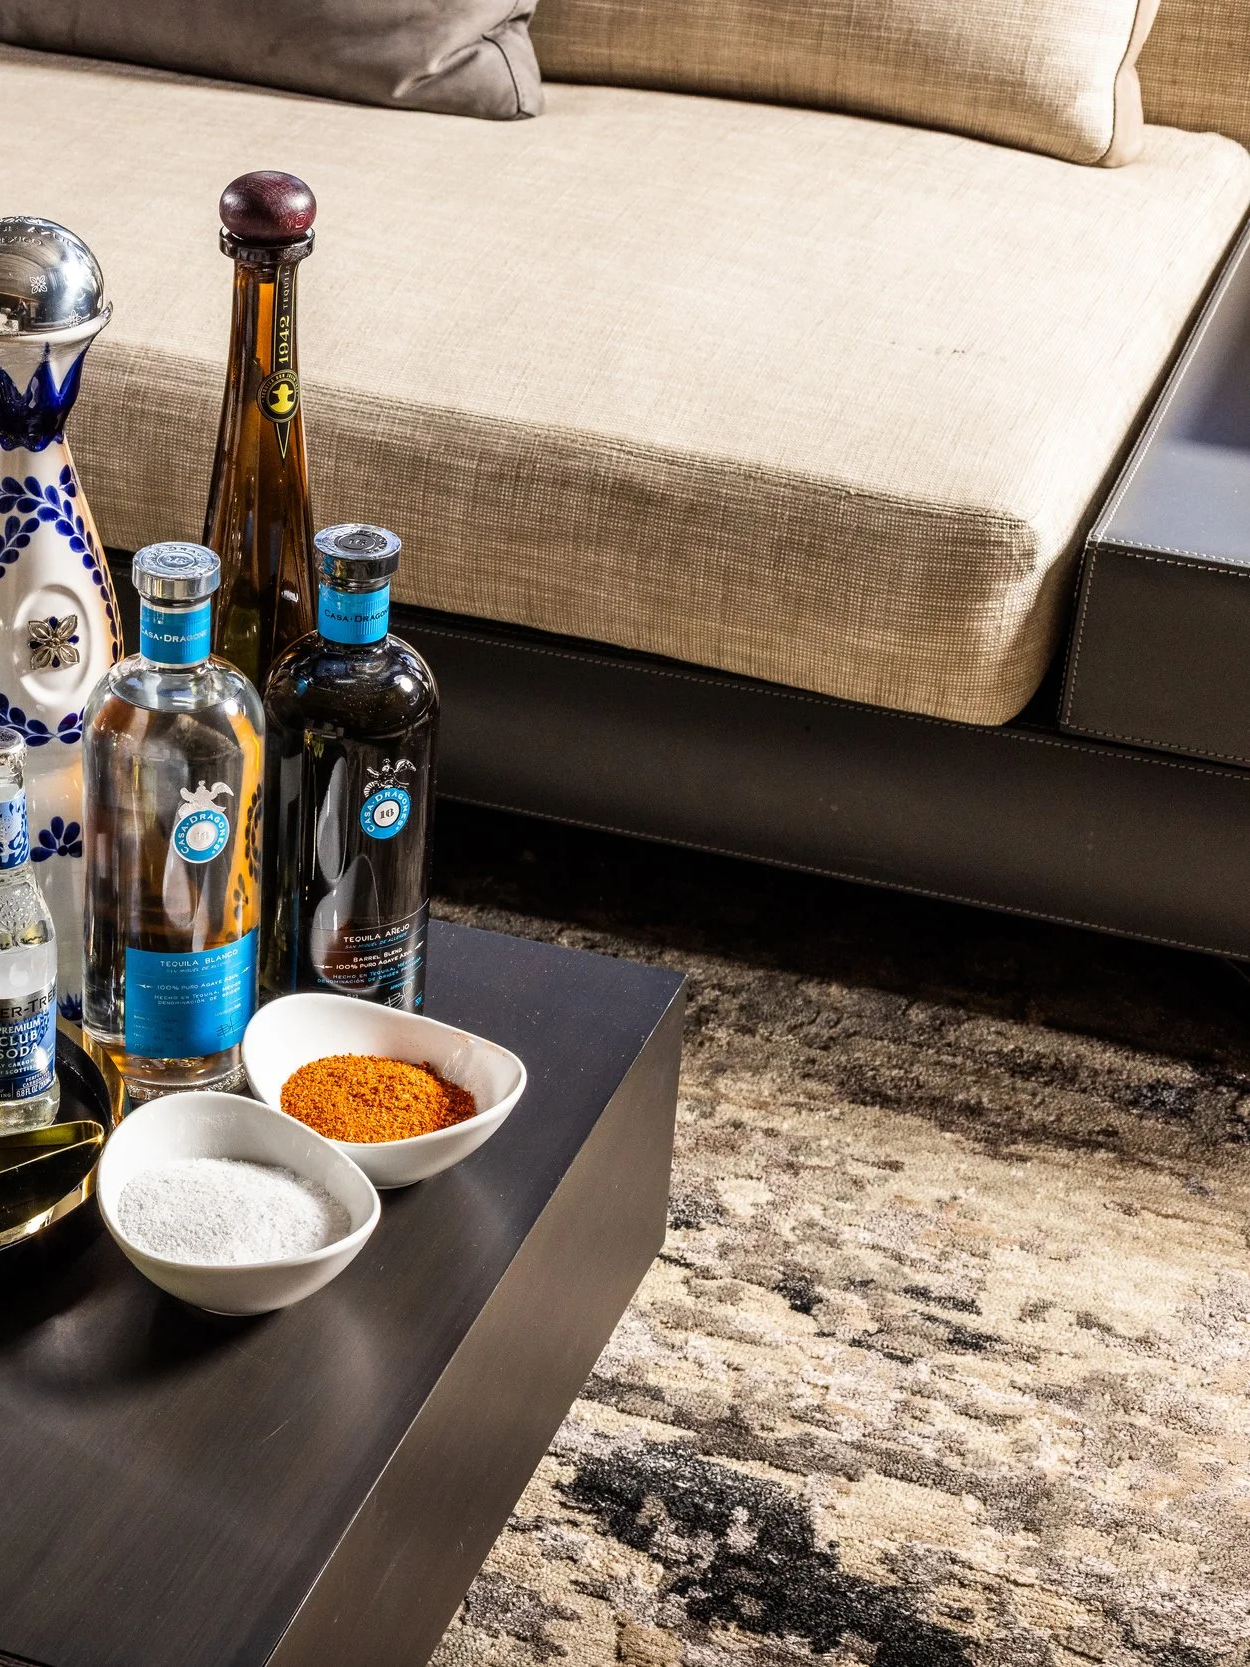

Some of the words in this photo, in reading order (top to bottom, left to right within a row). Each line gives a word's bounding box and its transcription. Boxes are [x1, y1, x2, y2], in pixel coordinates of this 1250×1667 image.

[278, 315, 290, 364] 1942
[325, 609, 349, 623] CASA
[364, 804, 375, 833] CASA
[375, 791, 409, 826] DRAGONES
[177, 825, 190, 854] CASA
[189, 813, 226, 851] DRAGONES
[343, 933, 381, 943] TEQUILA
[385, 923, 410, 937] AÑEJO
[160, 960, 199, 968] TEQUILA
[205, 948, 239, 965] BLANCO
[353, 954, 381, 963] BARREL
[383, 947, 403, 958] BLEND
[378, 956, 398, 965] AGAVE
